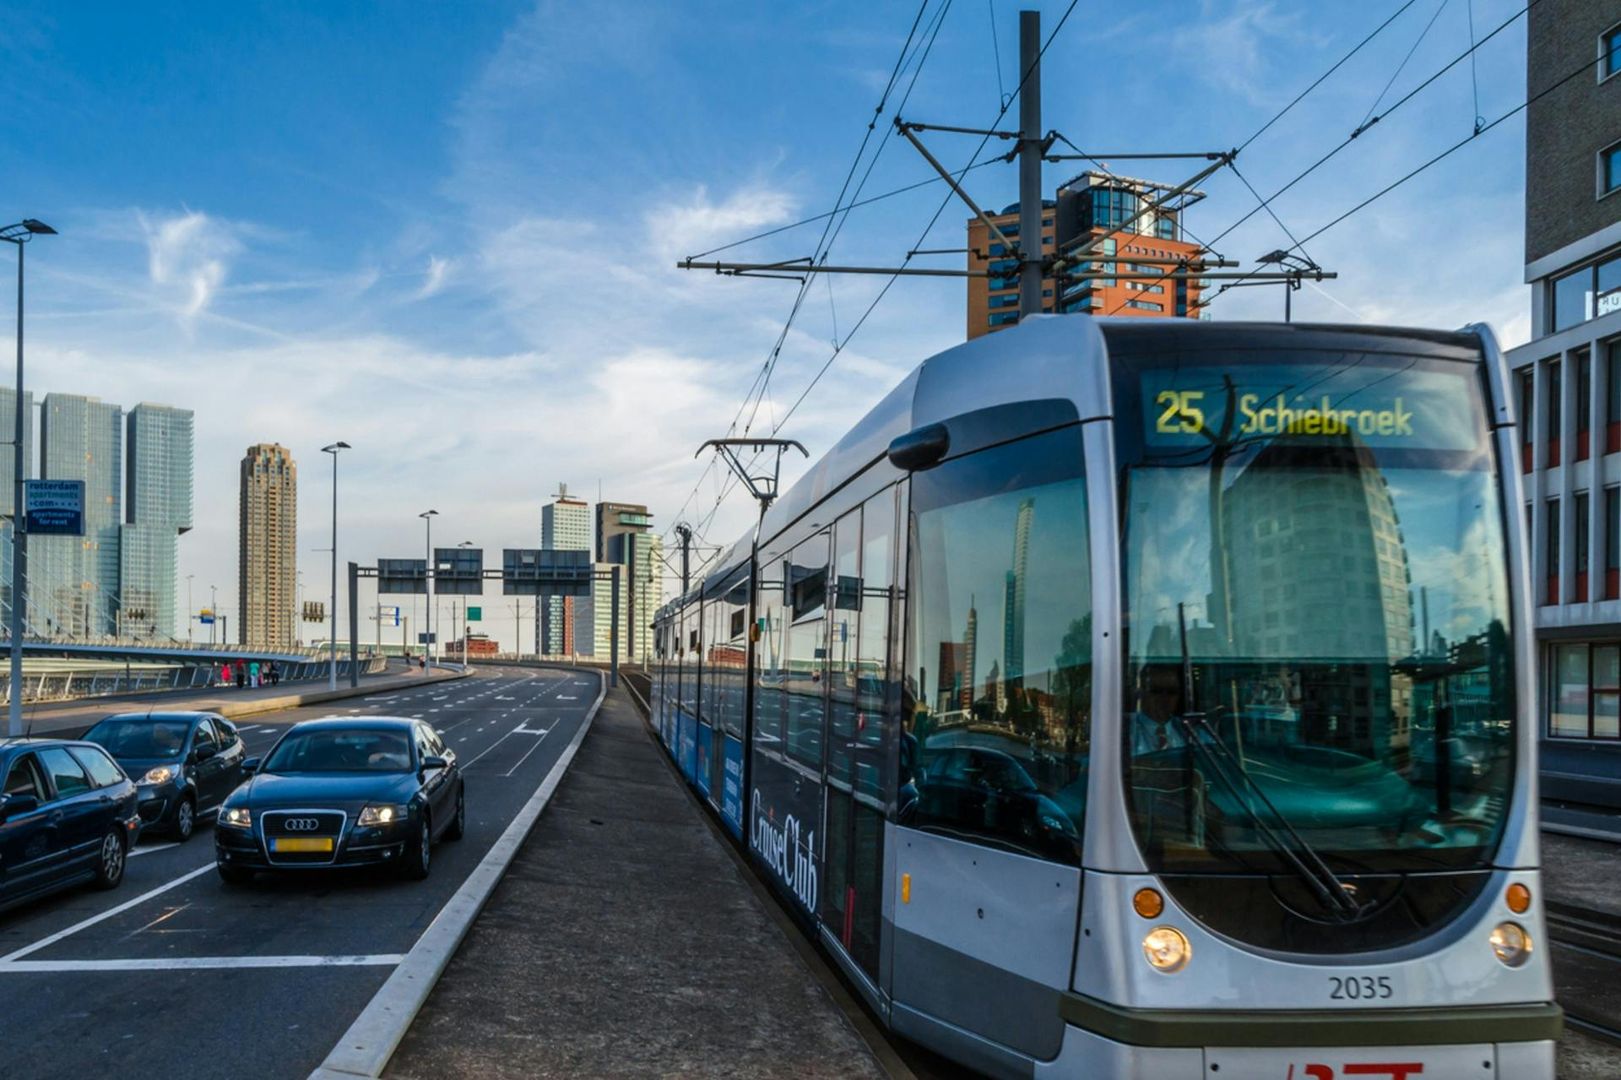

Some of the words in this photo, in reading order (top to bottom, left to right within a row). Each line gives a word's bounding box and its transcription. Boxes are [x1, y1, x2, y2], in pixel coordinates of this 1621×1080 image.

[1156, 391, 1205, 434] 25
[1239, 394, 1413, 436] Schiebroek
[30, 482, 78, 490] rotterdam
[752, 788, 817, 914] CruiseClub
[1328, 976, 1393, 1000] 2035
